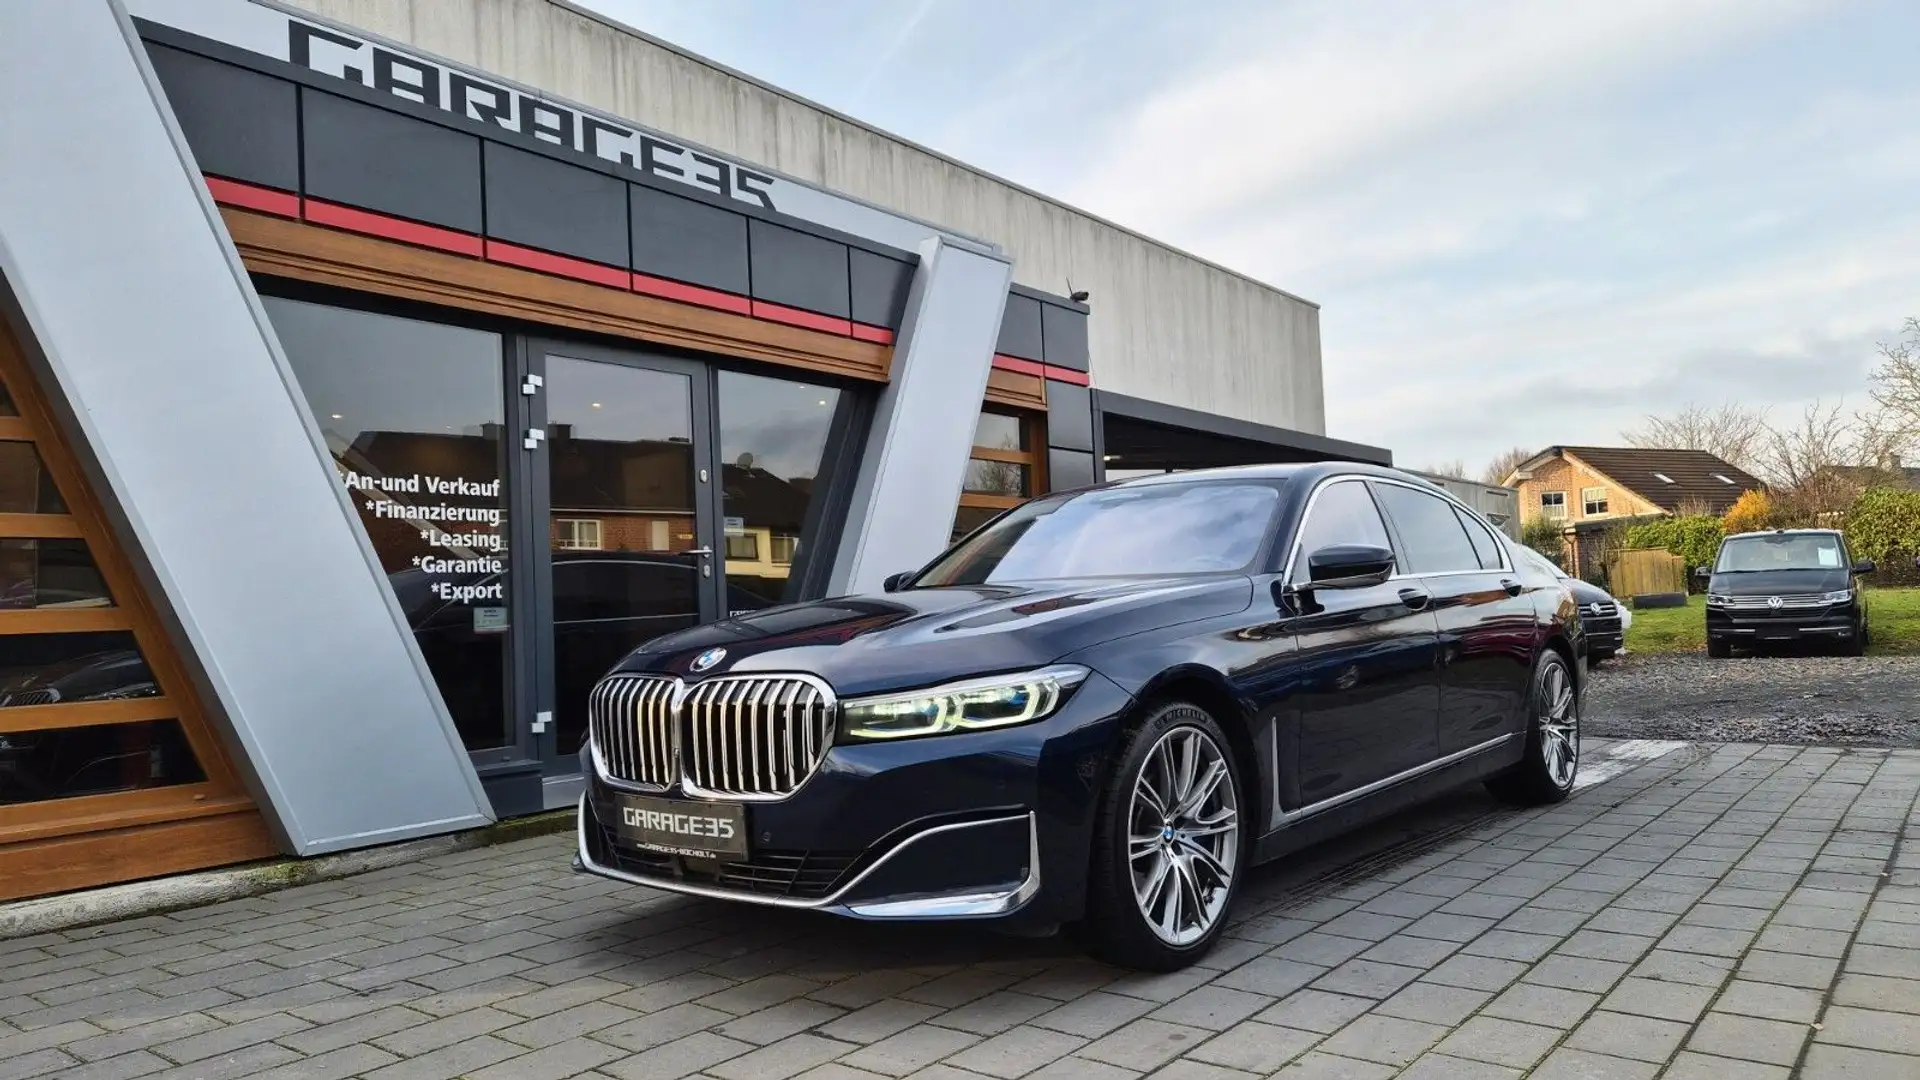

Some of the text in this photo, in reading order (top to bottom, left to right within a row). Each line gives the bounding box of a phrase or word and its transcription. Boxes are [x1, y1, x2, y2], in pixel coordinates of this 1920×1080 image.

[289, 19, 775, 211] GARAGE35
[425, 475, 500, 497] Verkauf
[623, 806, 735, 839] GARAGE35
